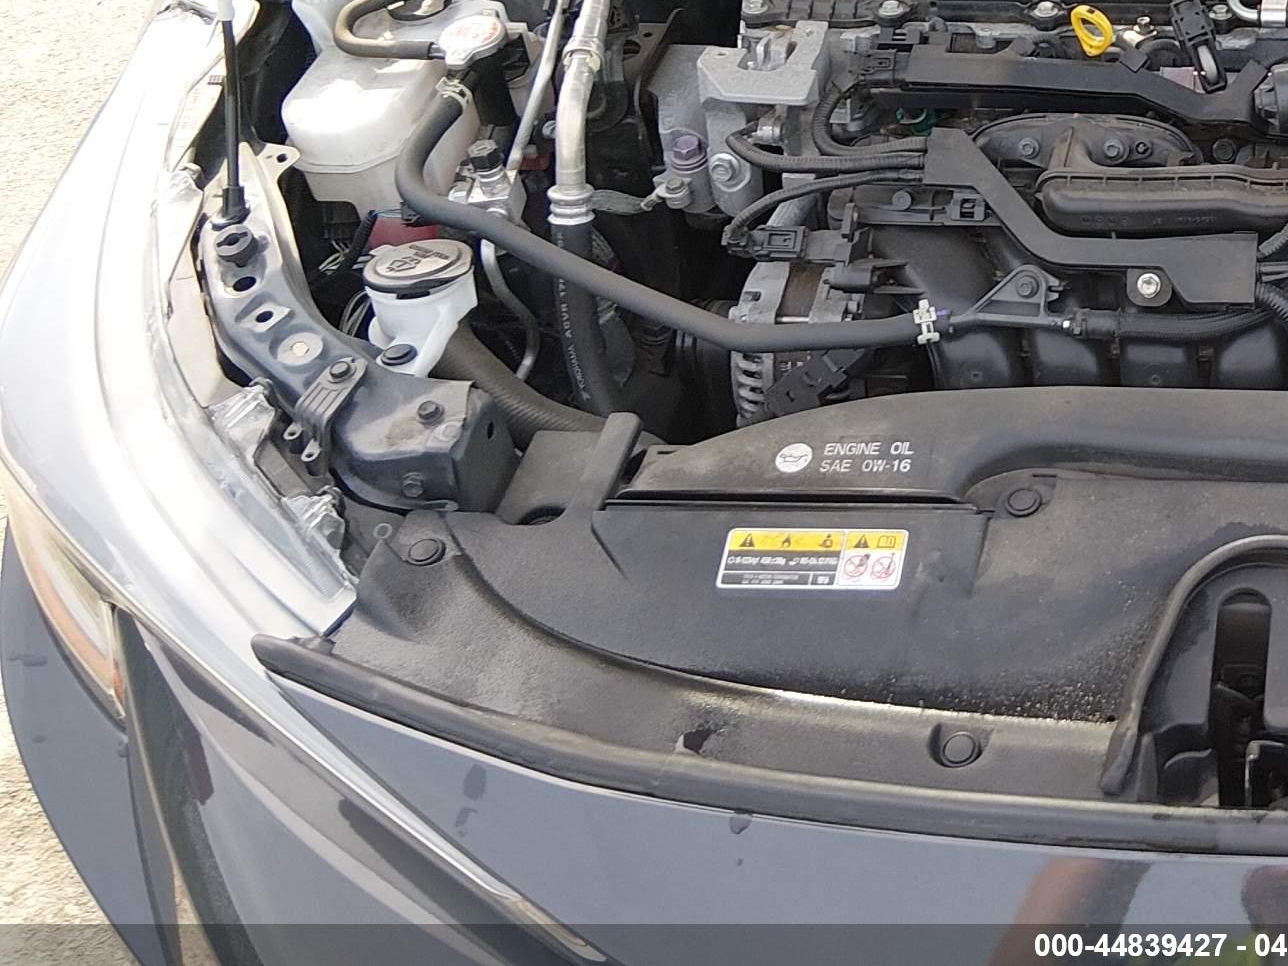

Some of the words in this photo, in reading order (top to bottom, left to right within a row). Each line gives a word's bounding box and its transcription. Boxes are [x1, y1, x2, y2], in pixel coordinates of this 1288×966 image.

[824, 442, 881, 455] ENGINE
[890, 441, 915, 455] OIL
[819, 459, 853, 473] SAE
[861, 458, 912, 473] 0W-16
